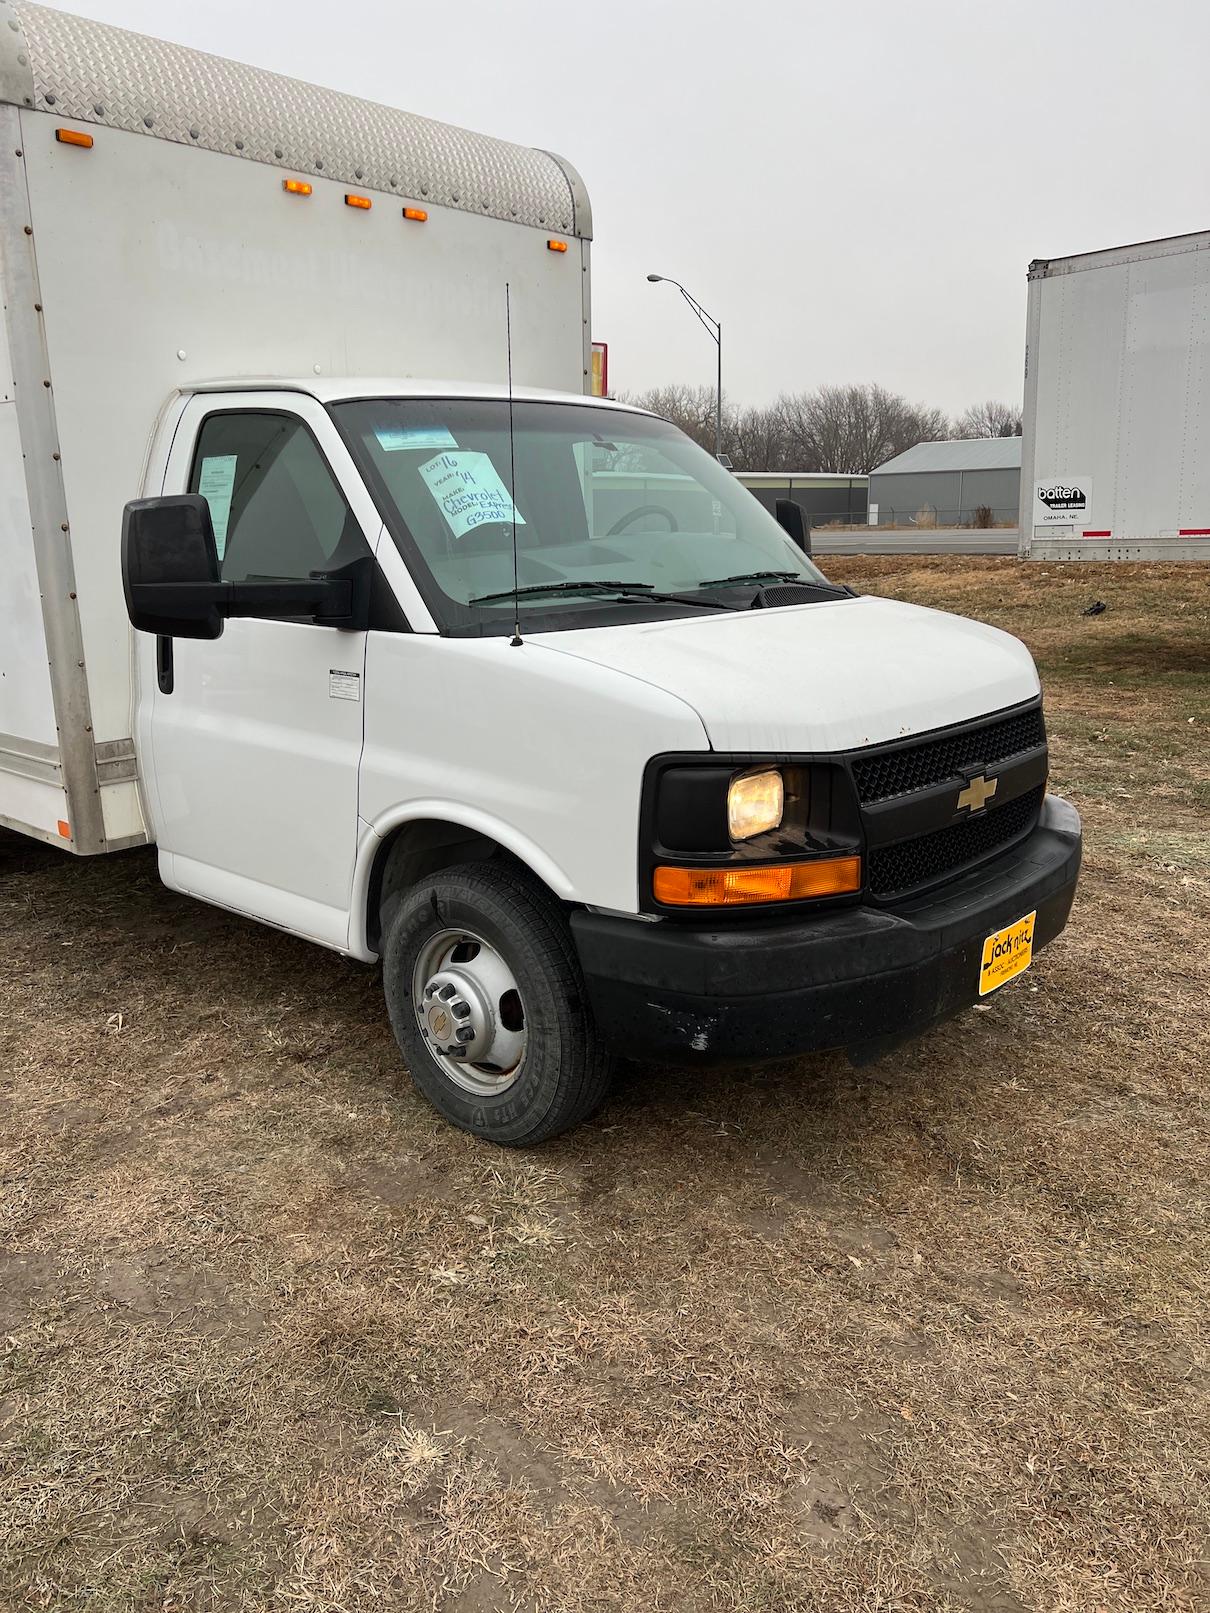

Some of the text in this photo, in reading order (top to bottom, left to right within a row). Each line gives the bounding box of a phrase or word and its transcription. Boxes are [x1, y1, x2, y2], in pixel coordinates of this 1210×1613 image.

[425, 455, 458, 473] LOT: 16
[433, 472, 455, 487] YEAR:
[443, 488, 505, 514] Chevrolet
[1038, 486, 1081, 500] batten
[450, 501, 479, 517] MODEL:
[466, 510, 506, 526] G3500
[983, 934, 1013, 970] jack
